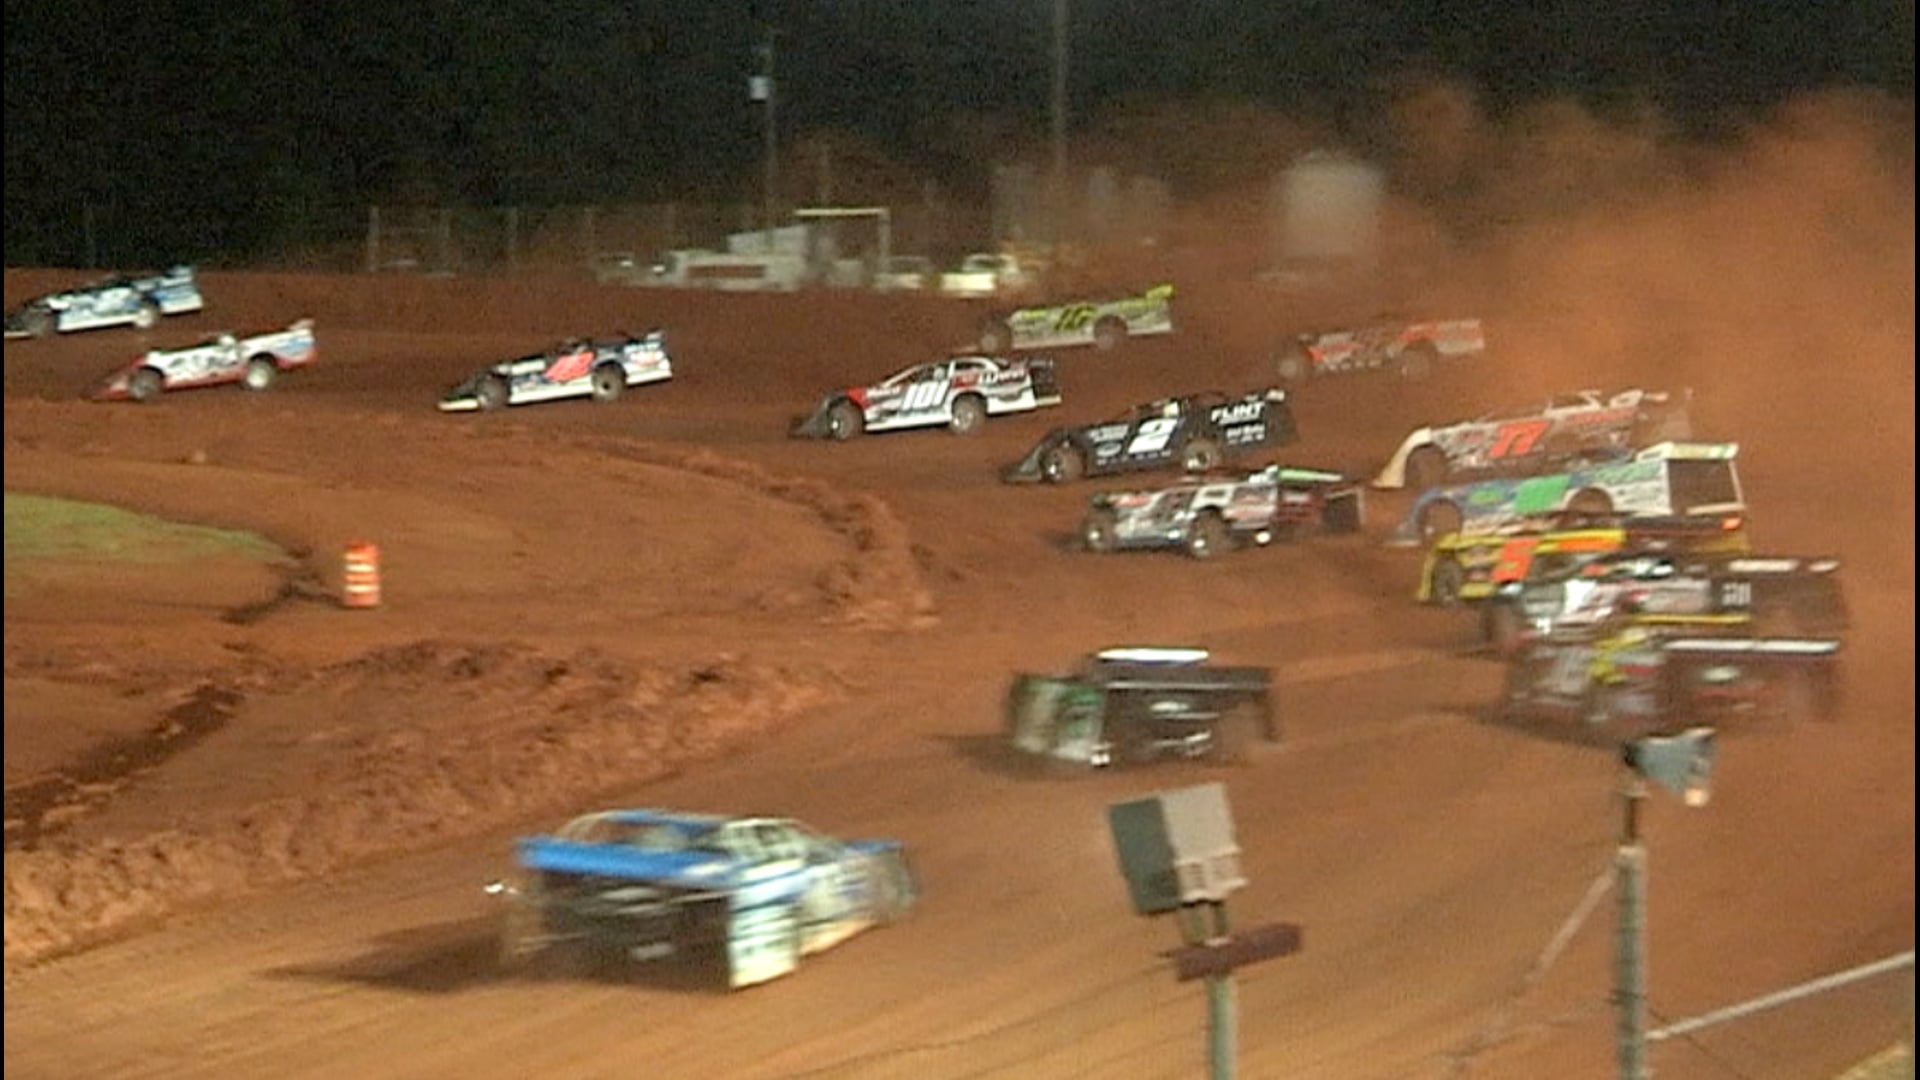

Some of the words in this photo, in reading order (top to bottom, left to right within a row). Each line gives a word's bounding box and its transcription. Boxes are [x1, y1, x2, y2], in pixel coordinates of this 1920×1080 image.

[902, 381, 950, 411] 101
[1211, 402, 1265, 423] FLINT
[1128, 418, 1178, 454] 2
[1488, 420, 1549, 457] 77
